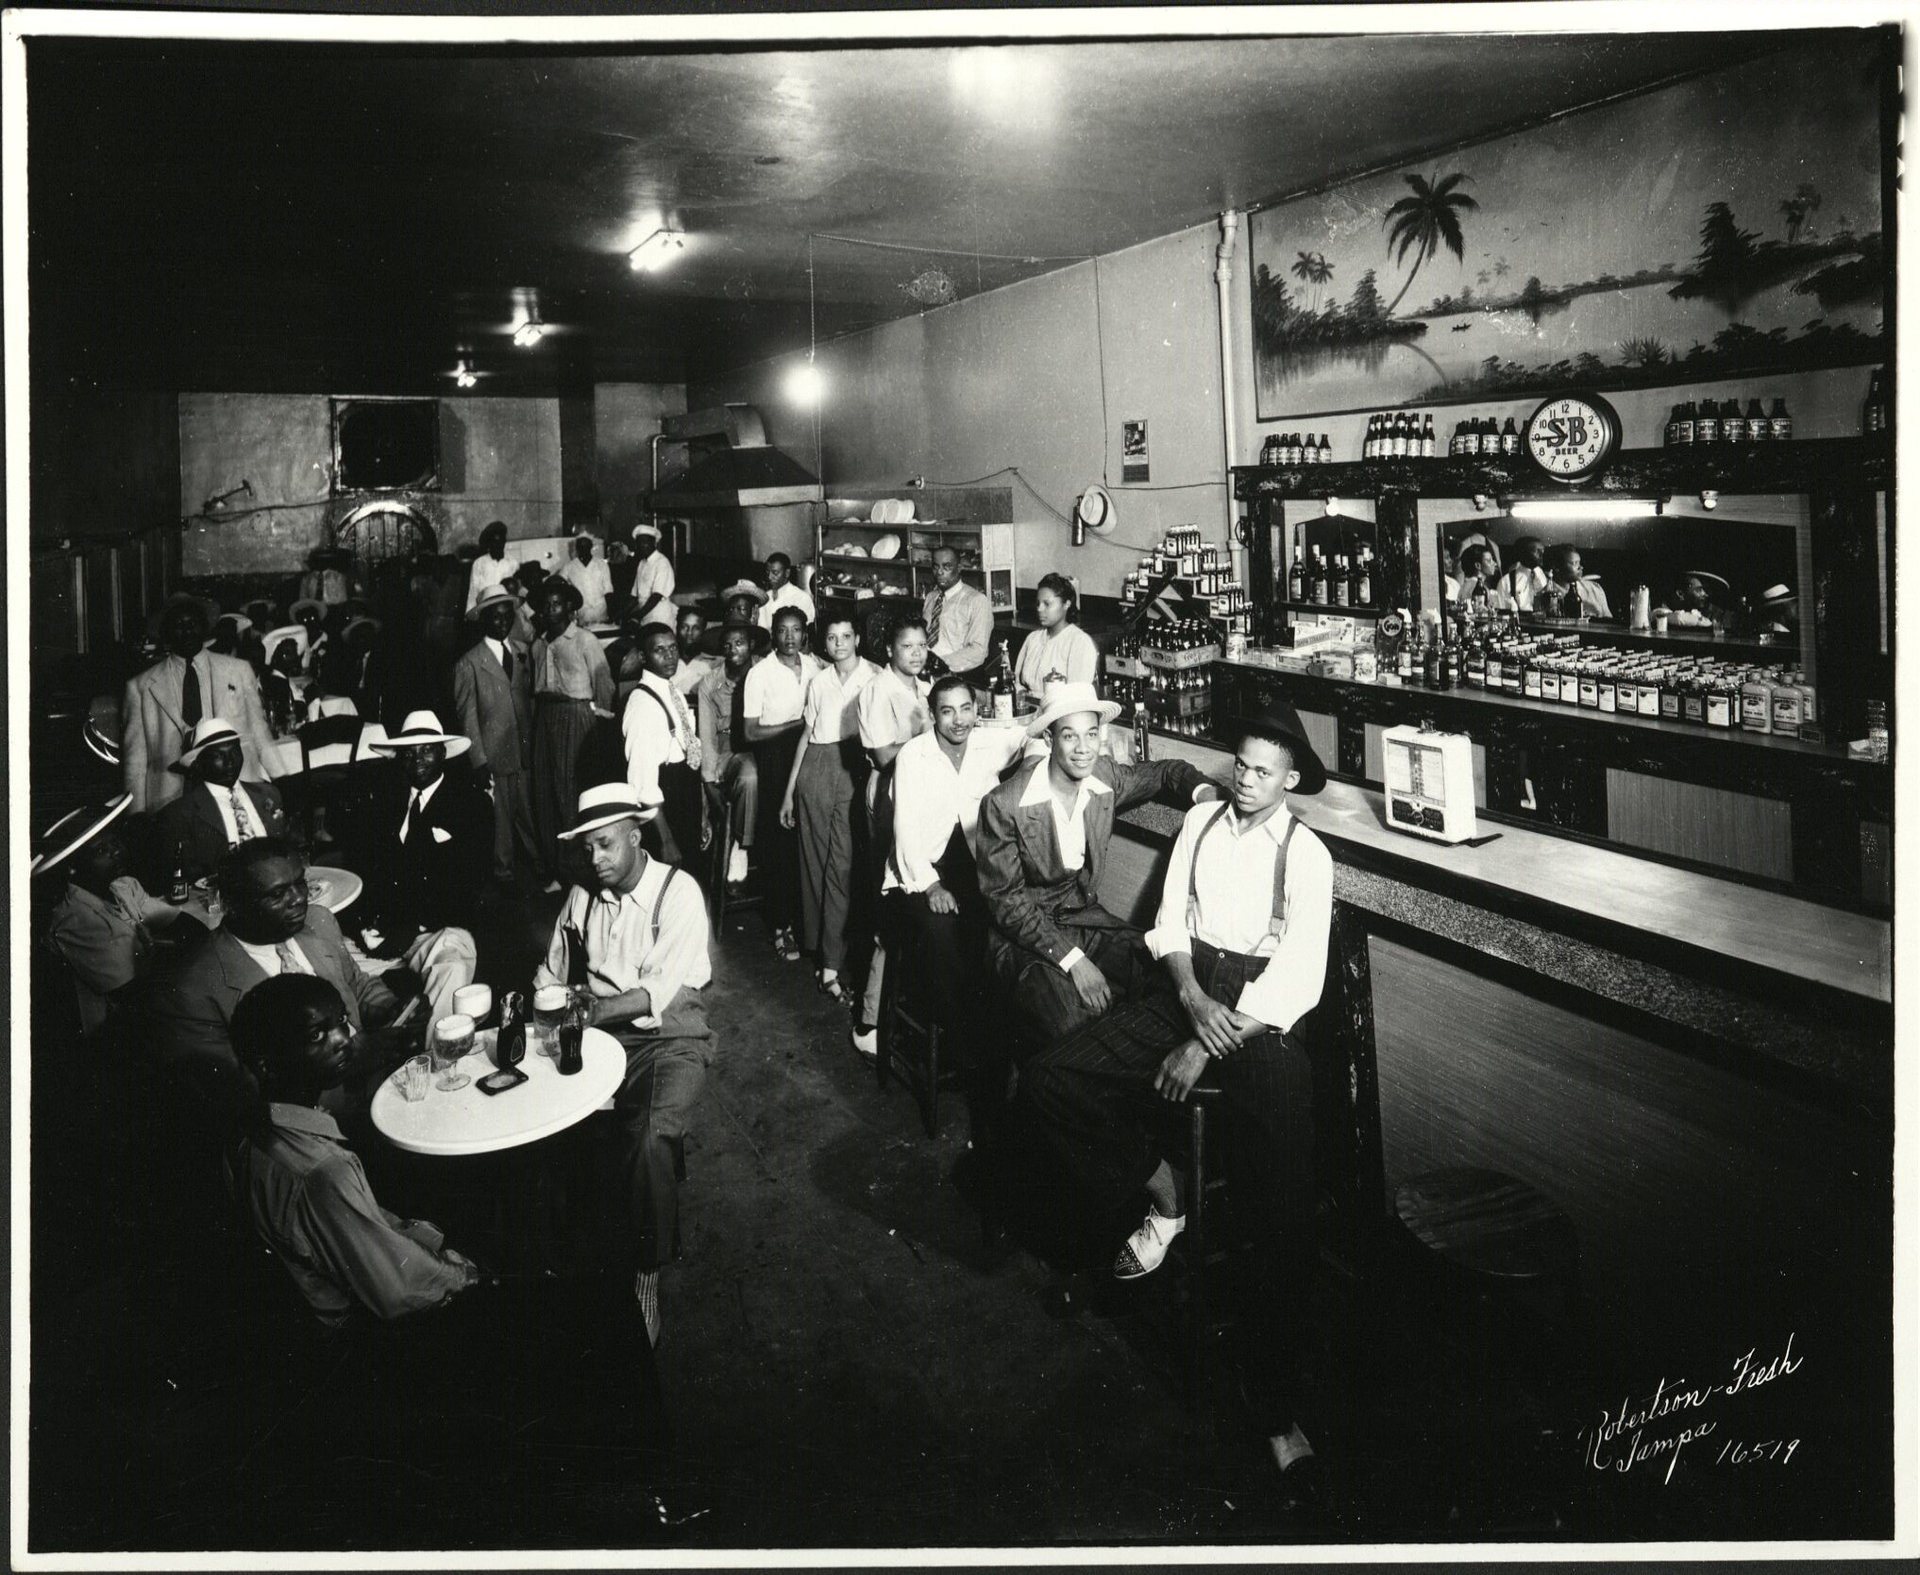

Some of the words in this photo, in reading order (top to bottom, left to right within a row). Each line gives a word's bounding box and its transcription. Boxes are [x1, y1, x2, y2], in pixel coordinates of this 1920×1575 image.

[1550, 409, 1556, 418] 11
[1562, 404, 1570, 414] 12
[1539, 419, 1547, 428] 10
[1588, 416, 1594, 425] 2
[1546, 416, 1588, 448] SB
[1592, 430, 1599, 439] 3
[1534, 433, 1540, 442] 9
[1538, 447, 1545, 456] 8
[1555, 448, 1578, 456] BEER
[1588, 444, 1595, 453] 4
[1550, 456, 1556, 466] 7
[1564, 459, 1570, 468] 6
[1578, 454, 1585, 464] 5
